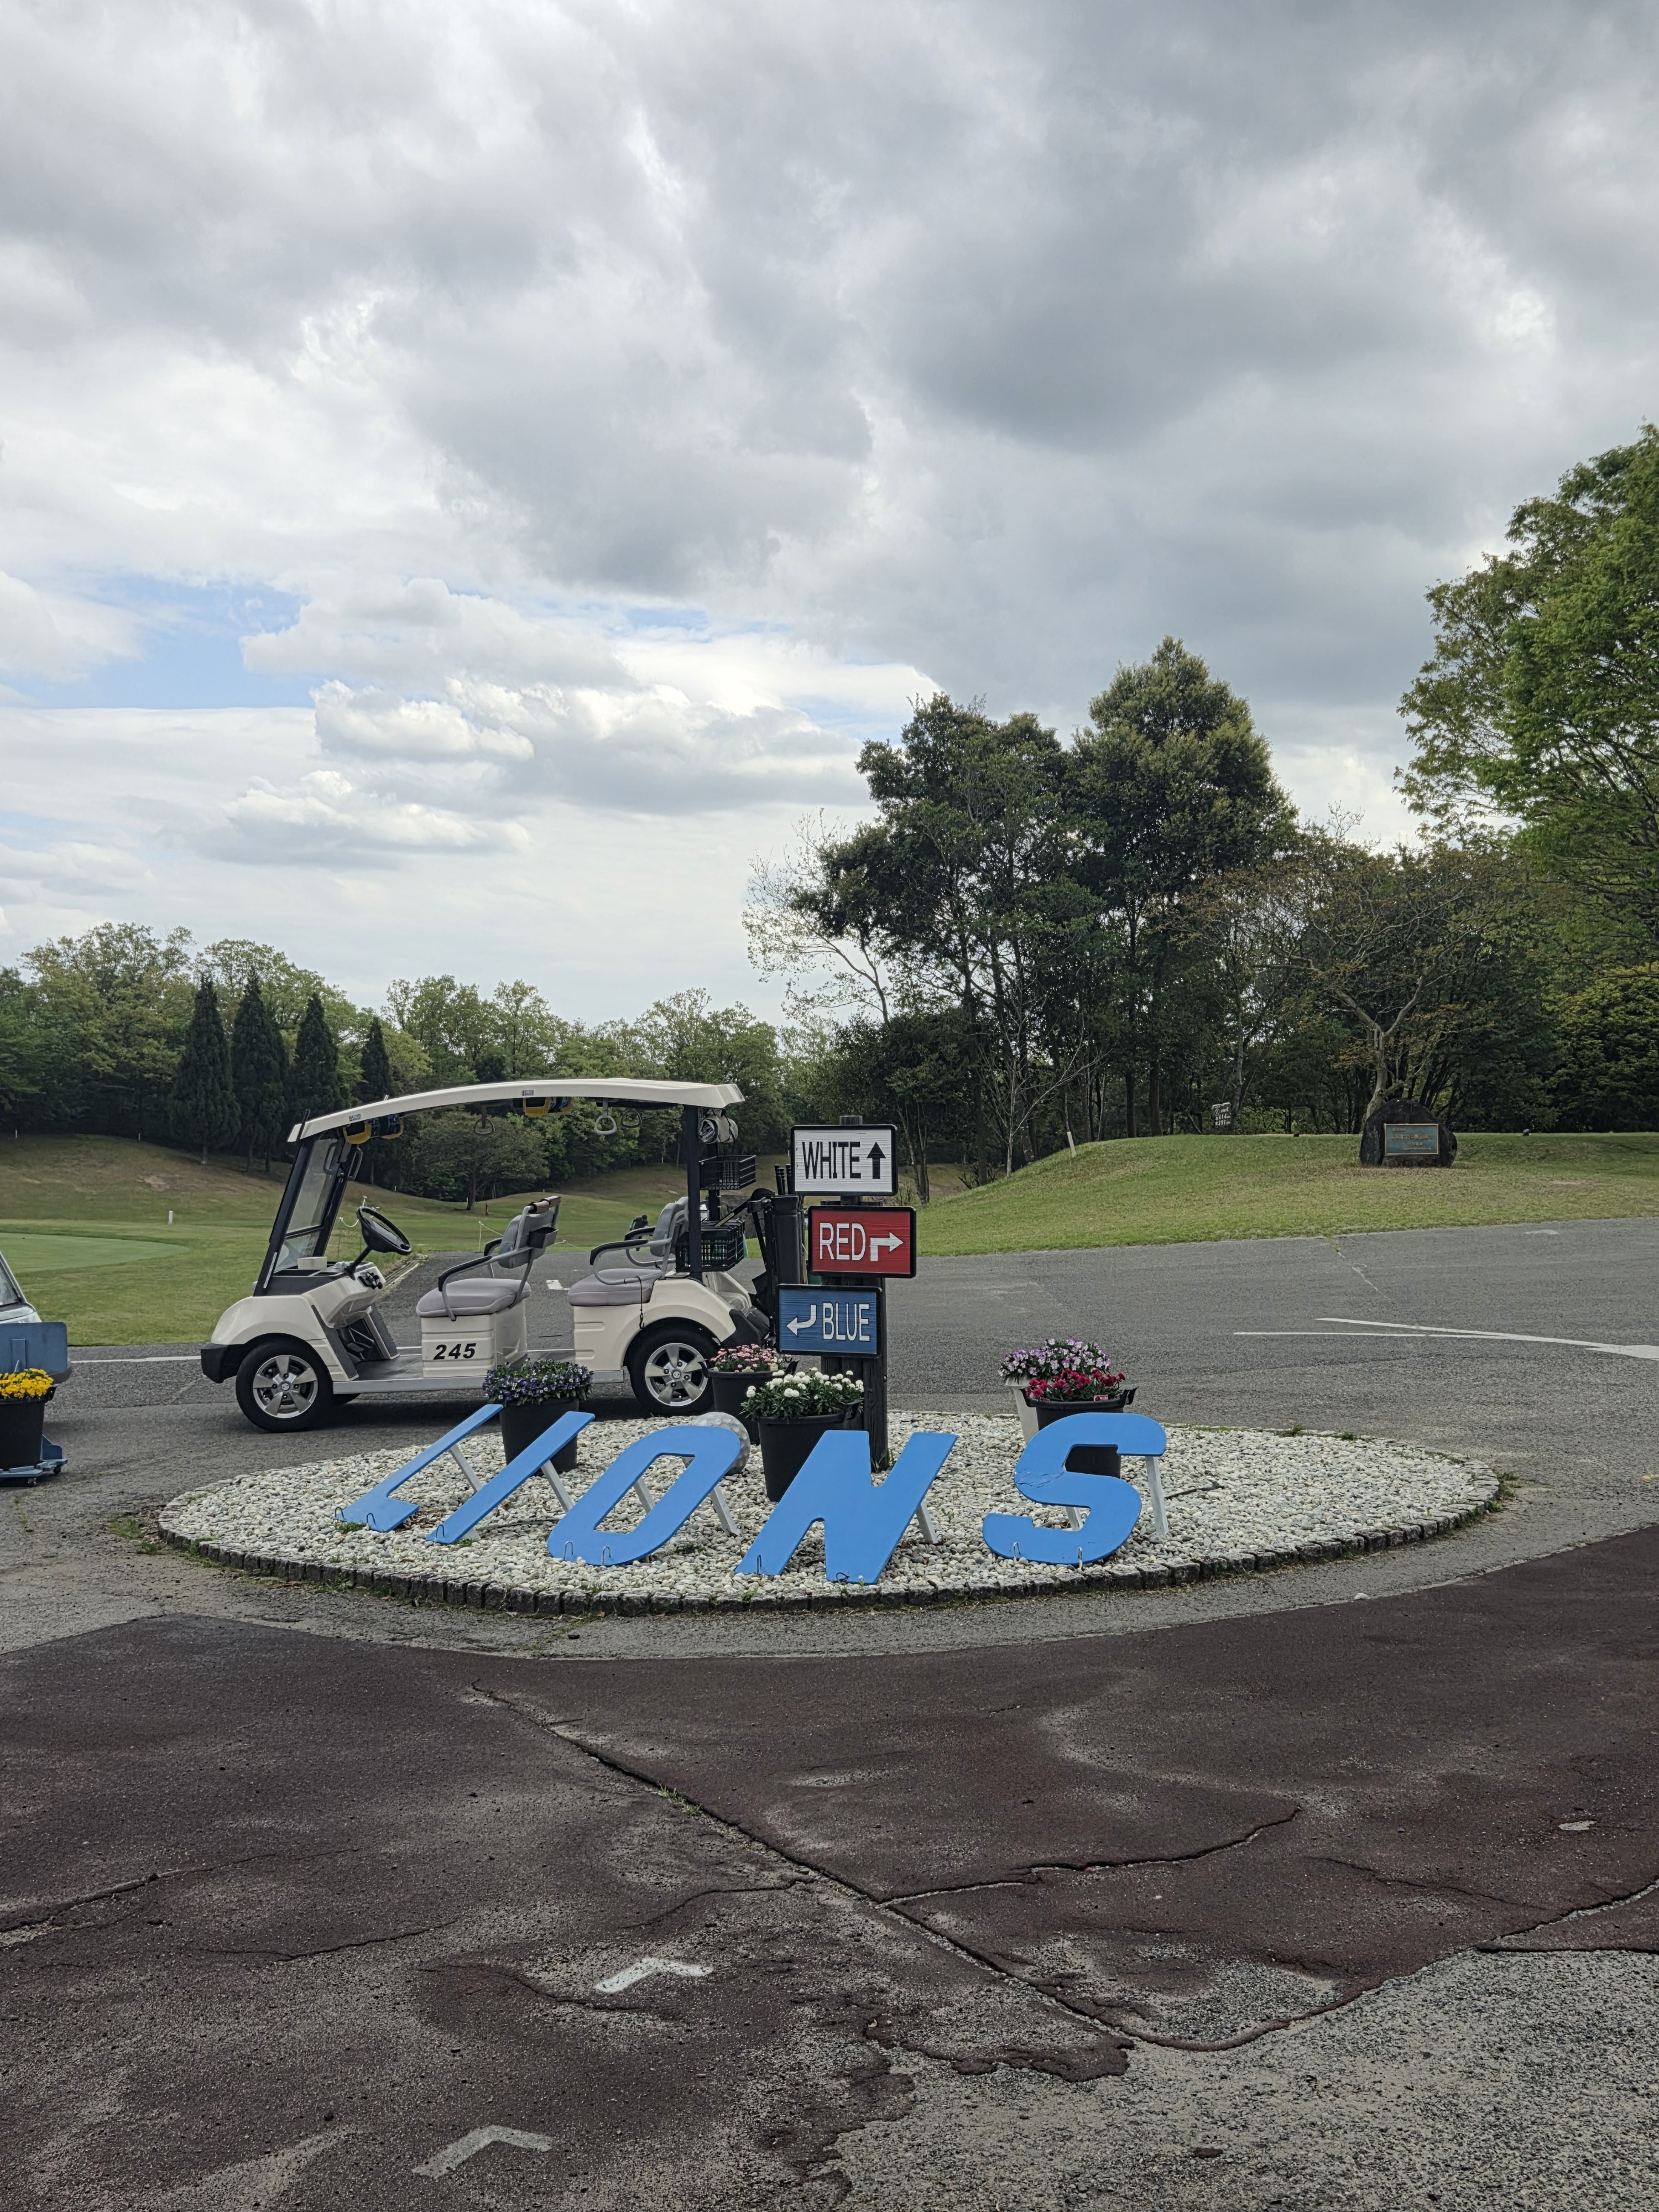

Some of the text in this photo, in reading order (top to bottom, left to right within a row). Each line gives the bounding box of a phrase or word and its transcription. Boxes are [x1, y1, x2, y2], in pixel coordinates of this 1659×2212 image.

[802, 1141, 862, 1180] WHITE
[820, 1222, 866, 1261] RED
[823, 1302, 870, 1342] BLUE
[433, 1343, 477, 1360] 245
[336, 1404, 1167, 1585] LIONS
